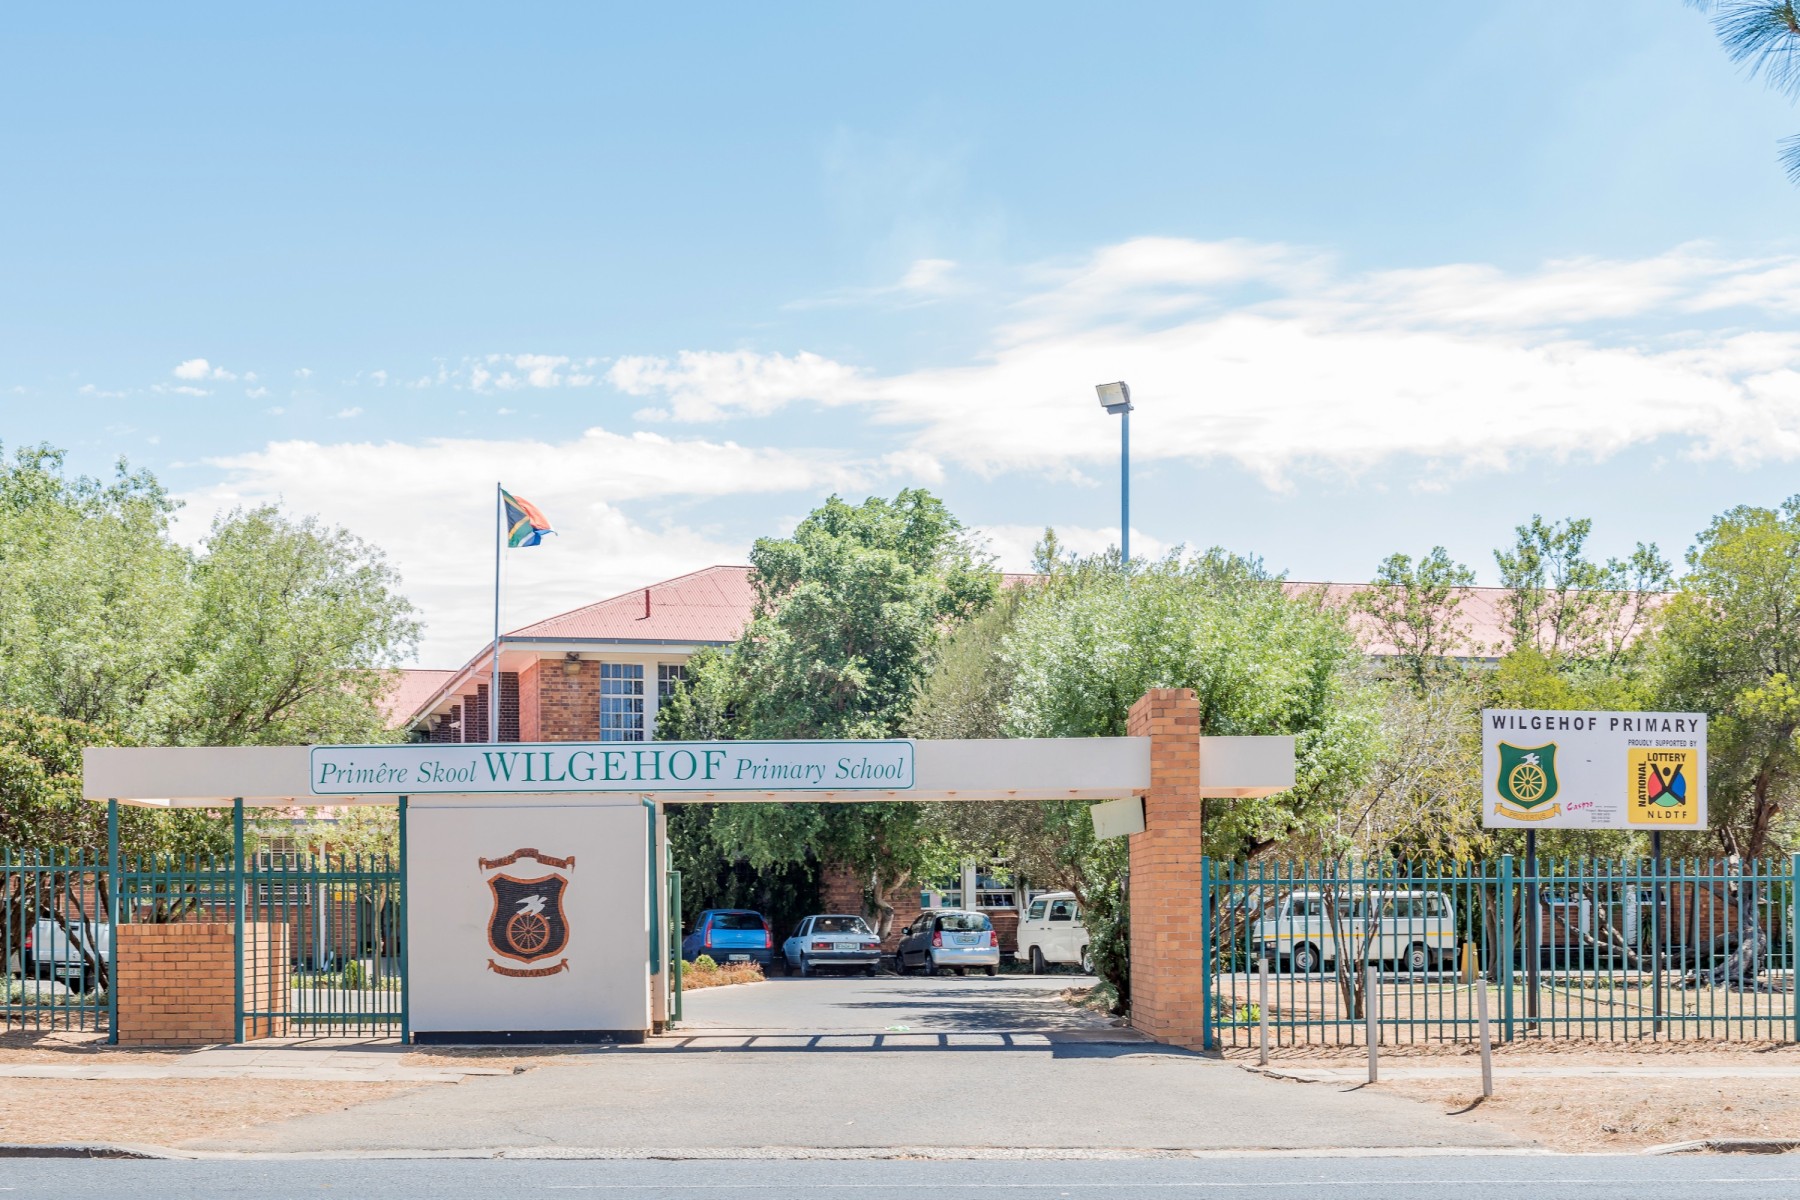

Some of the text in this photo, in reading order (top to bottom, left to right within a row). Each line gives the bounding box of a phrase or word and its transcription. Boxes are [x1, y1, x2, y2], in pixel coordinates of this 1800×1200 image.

[1492, 715, 1698, 733] WILGEHOF PRIMARY
[1628, 739, 1652, 747] PROUDLY
[1647, 752, 1687, 762] LOTTERY
[318, 750, 904, 784] Primêre Skool WILGEHOF Primary School
[1638, 761, 1646, 807] NATIONAL
